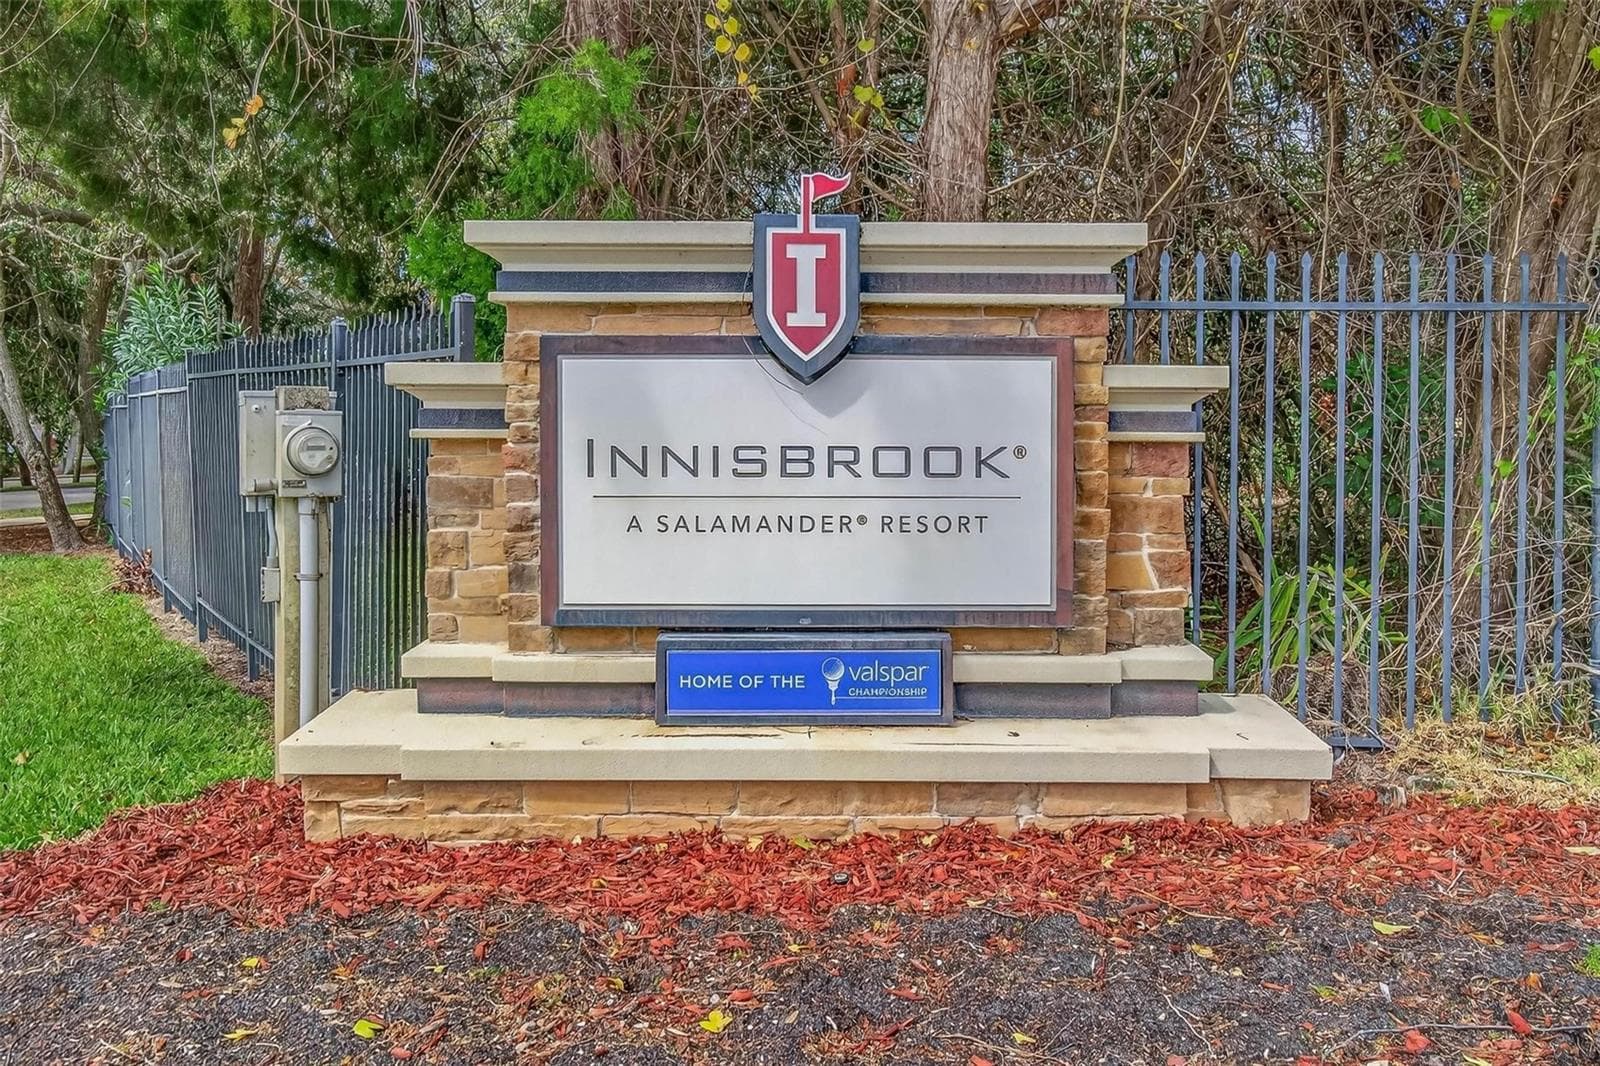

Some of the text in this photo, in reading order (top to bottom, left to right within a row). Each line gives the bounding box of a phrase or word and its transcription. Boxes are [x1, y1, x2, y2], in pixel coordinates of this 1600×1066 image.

[786, 244, 826, 326] I
[626, 515, 642, 533] A
[881, 515, 989, 534] RESORT
[679, 675, 805, 688] HOME OF THE
[848, 660, 928, 686] valspar
[848, 687, 927, 697] CHAMPIONSHIP
